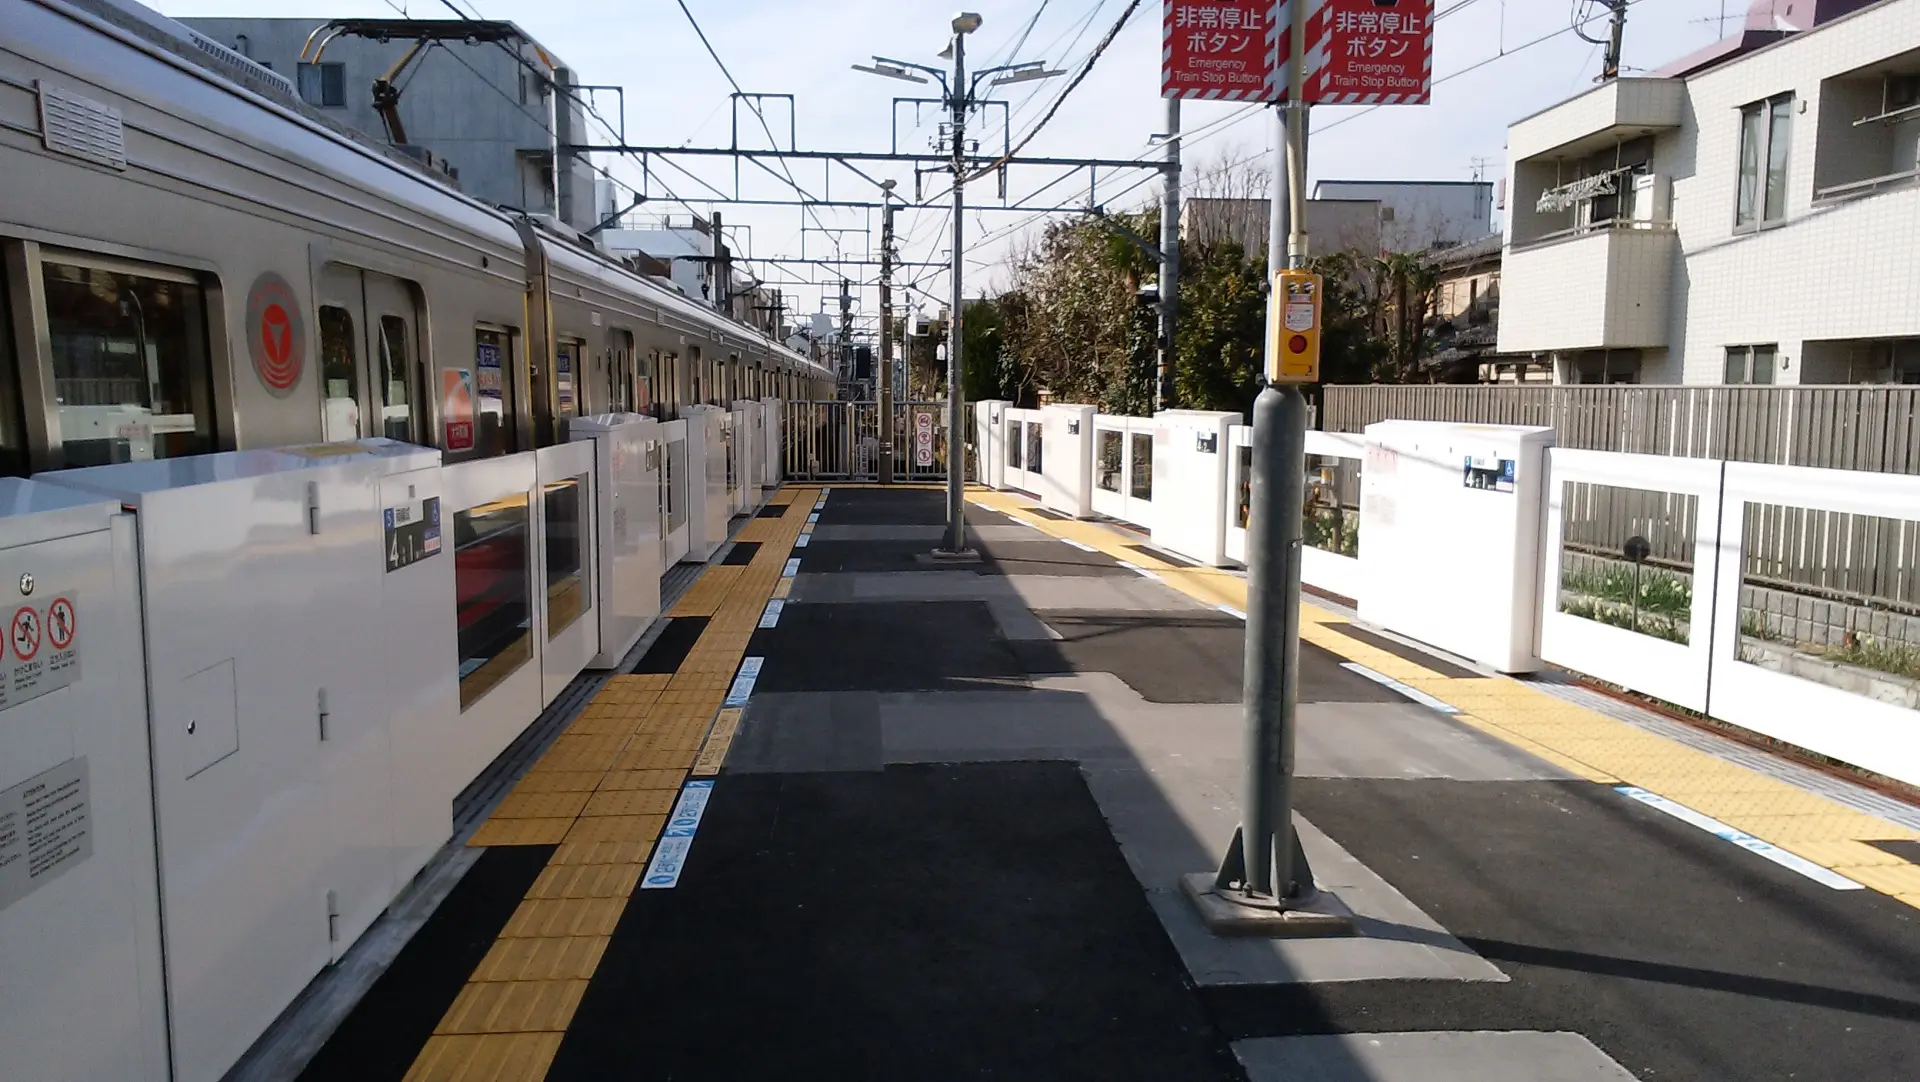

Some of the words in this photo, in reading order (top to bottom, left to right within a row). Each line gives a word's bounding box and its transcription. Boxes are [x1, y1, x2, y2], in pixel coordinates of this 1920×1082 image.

[1176, 6, 1262, 29] 非常停止
[1336, 11, 1421, 34] 非常停止
[1187, 31, 1250, 53] ボタン
[1346, 36, 1409, 58] ボタン
[1188, 57, 1246, 71] Emergency
[1348, 62, 1405, 75] Emergency
[1175, 71, 1198, 82] Train
[1202, 71, 1226, 84] Stop
[1228, 72, 1260, 83] Button
[1334, 75, 1358, 86] Train
[1361, 76, 1385, 88] Stop
[1387, 76, 1419, 87] Button
[1466, 469, 1474, 487] 4
[390, 528, 399, 567] 4
[409, 534, 414, 561] 1
